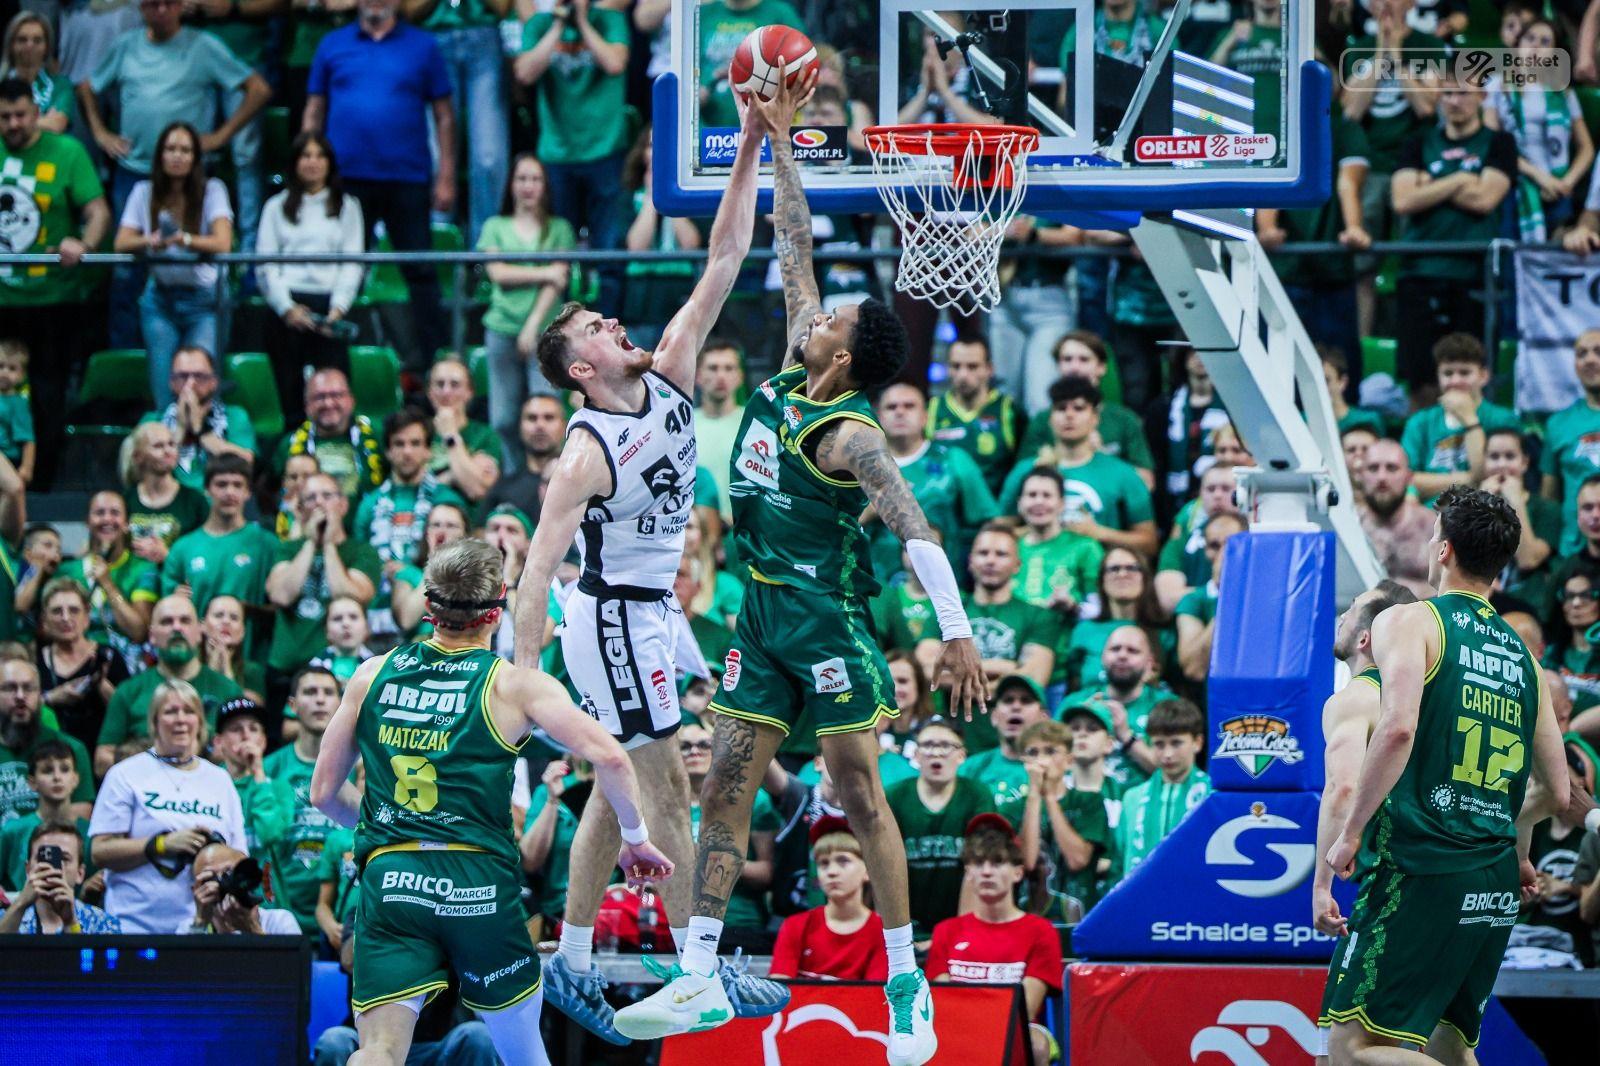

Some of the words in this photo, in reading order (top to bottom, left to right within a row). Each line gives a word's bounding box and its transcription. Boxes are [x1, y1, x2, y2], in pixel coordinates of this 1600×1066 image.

[1141, 140, 1200, 156] ORLEN
[1234, 136, 1268, 144] Basket
[1234, 147, 1255, 156] Liga
[745, 459, 774, 481] ORLEN
[601, 599, 642, 711] LEGIA
[1458, 644, 1526, 688] ARPOL
[378, 683, 467, 713] ARPOL
[820, 680, 845, 692] ORLEN
[1462, 684, 1521, 728] CARTIER
[378, 724, 452, 751] MATCZAK
[1451, 716, 1525, 794] 12
[144, 792, 222, 820] Zastal
[382, 871, 454, 896] BRICO
[439, 904, 493, 915] POMORSKIE
[1461, 892, 1513, 911] BRICO
[1151, 922, 1268, 942] Schelde
[483, 956, 531, 988] perceptus
